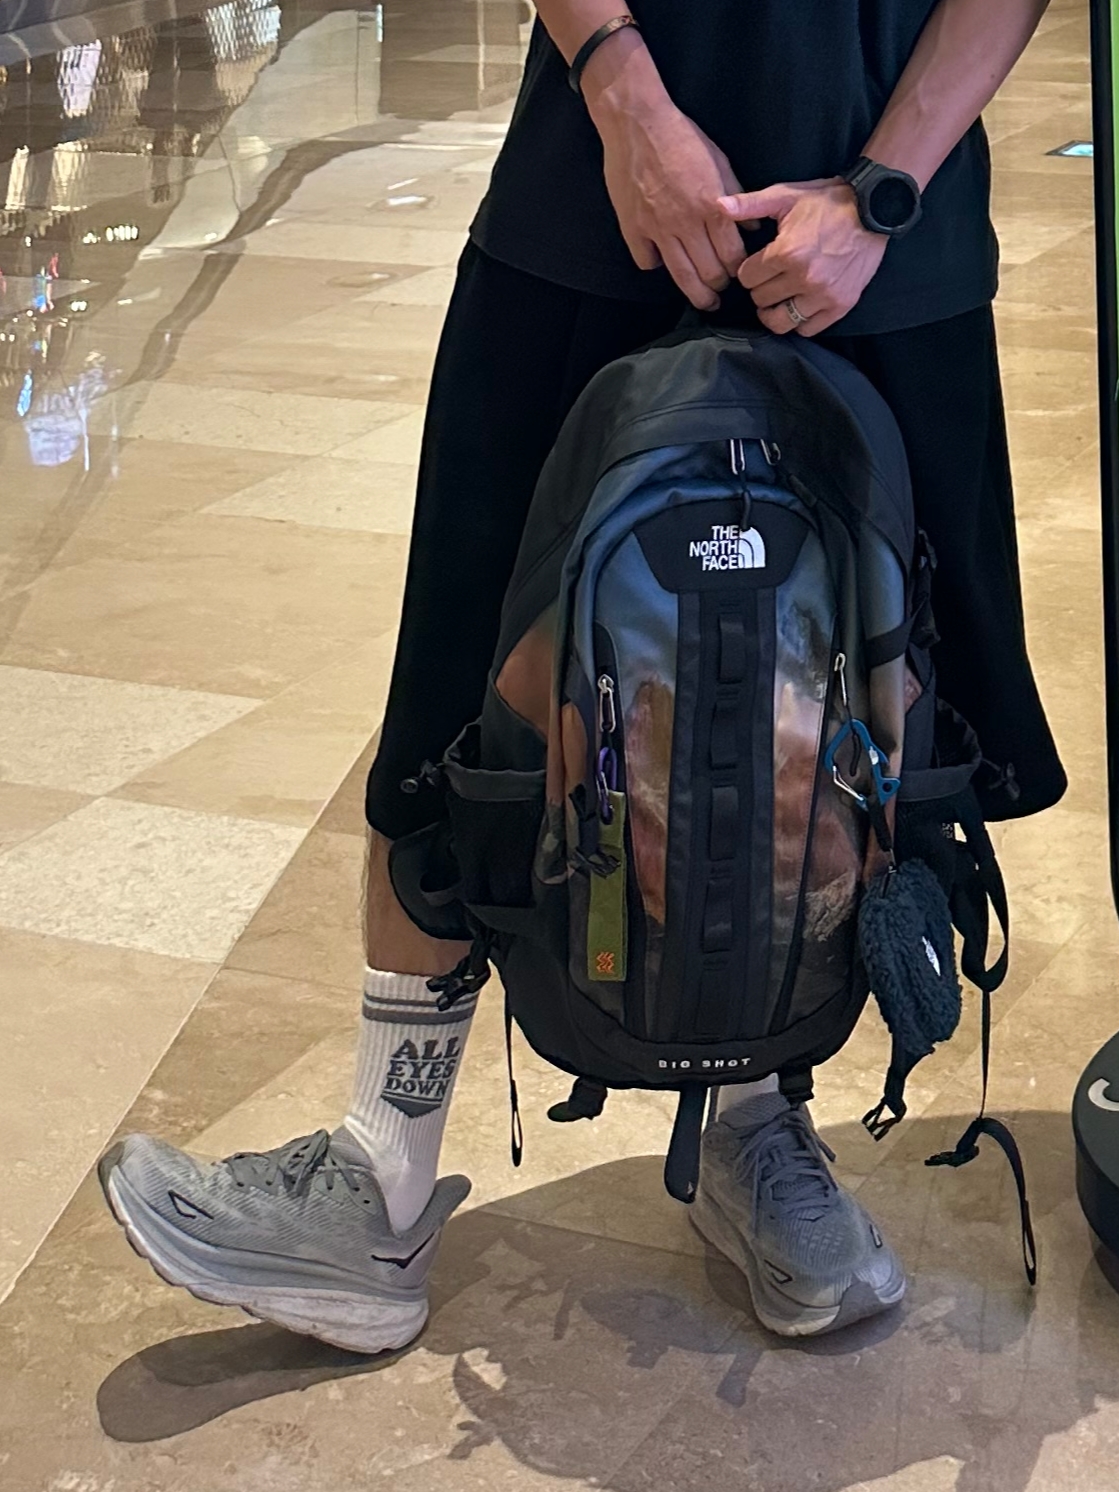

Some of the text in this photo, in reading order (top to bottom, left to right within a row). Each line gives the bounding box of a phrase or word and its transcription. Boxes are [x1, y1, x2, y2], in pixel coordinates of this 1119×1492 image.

[711, 525, 739, 540] THE
[689, 540, 738, 557] NORTH
[702, 555, 738, 571] FACE
[391, 1036, 461, 1060] ALL
[387, 1059, 457, 1079] EYES
[702, 1057, 751, 1068] SHOT
[384, 1077, 451, 1096] DOWN
